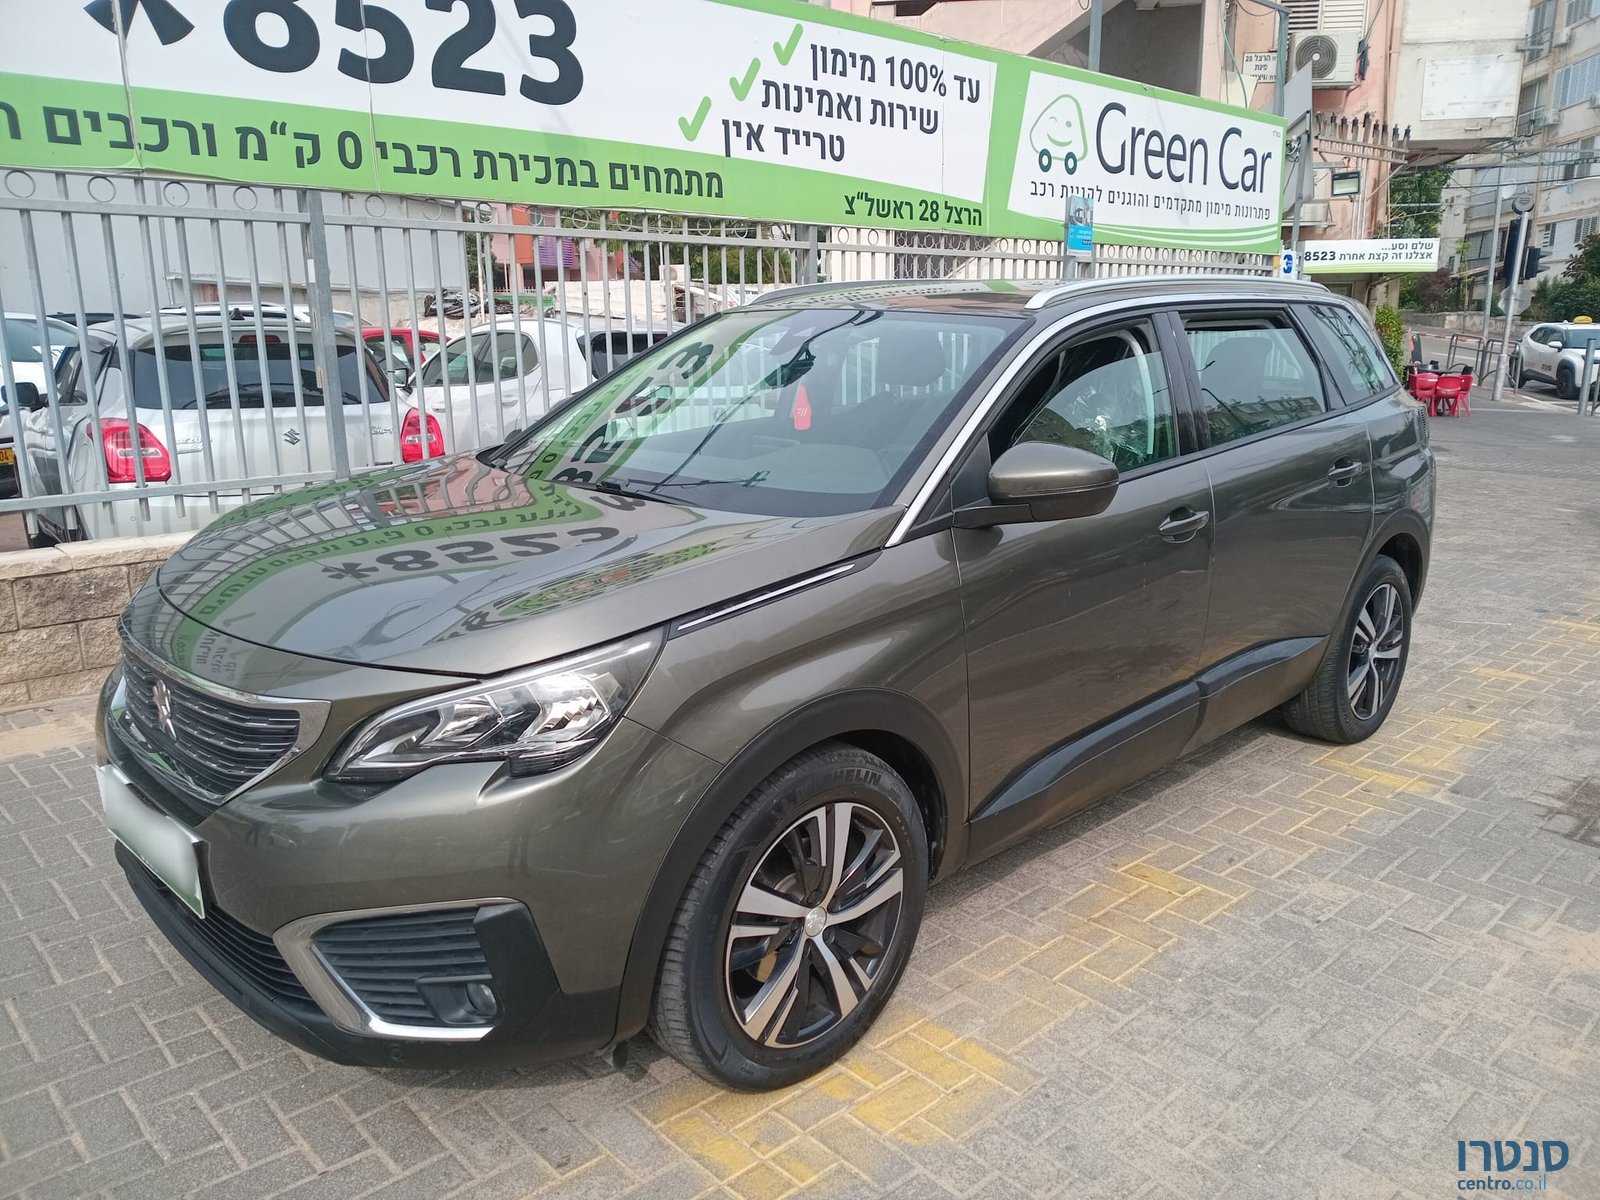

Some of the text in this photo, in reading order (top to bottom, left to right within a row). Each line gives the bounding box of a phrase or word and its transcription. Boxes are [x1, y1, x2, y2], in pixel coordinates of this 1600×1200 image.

[810, 44, 981, 103] עד 100% מימון
[761, 79, 939, 134] שירות ואמינות
[42, 105, 218, 158] ורכבים
[234, 119, 321, 169] ק"מ
[337, 130, 363, 170] 0
[722, 119, 845, 162] טרייד אין
[1096, 101, 1272, 193] Green Car
[375, 141, 462, 178] רכבי
[473, 150, 600, 189] במכירת
[608, 162, 724, 198] מתמחים
[1030, 180, 1055, 198] רכב
[1108, 189, 1149, 208] והוגנים
[843, 190, 982, 227] הרצל 28 ראשל"צ
[1154, 195, 1202, 215] מתקדמים
[1206, 202, 1231, 217] מימון
[1235, 203, 1271, 221] פתרונות
[1304, 250, 1433, 262] אצלנו זה קצת אחרת 8523
[1411, 241, 1434, 250] שלם
